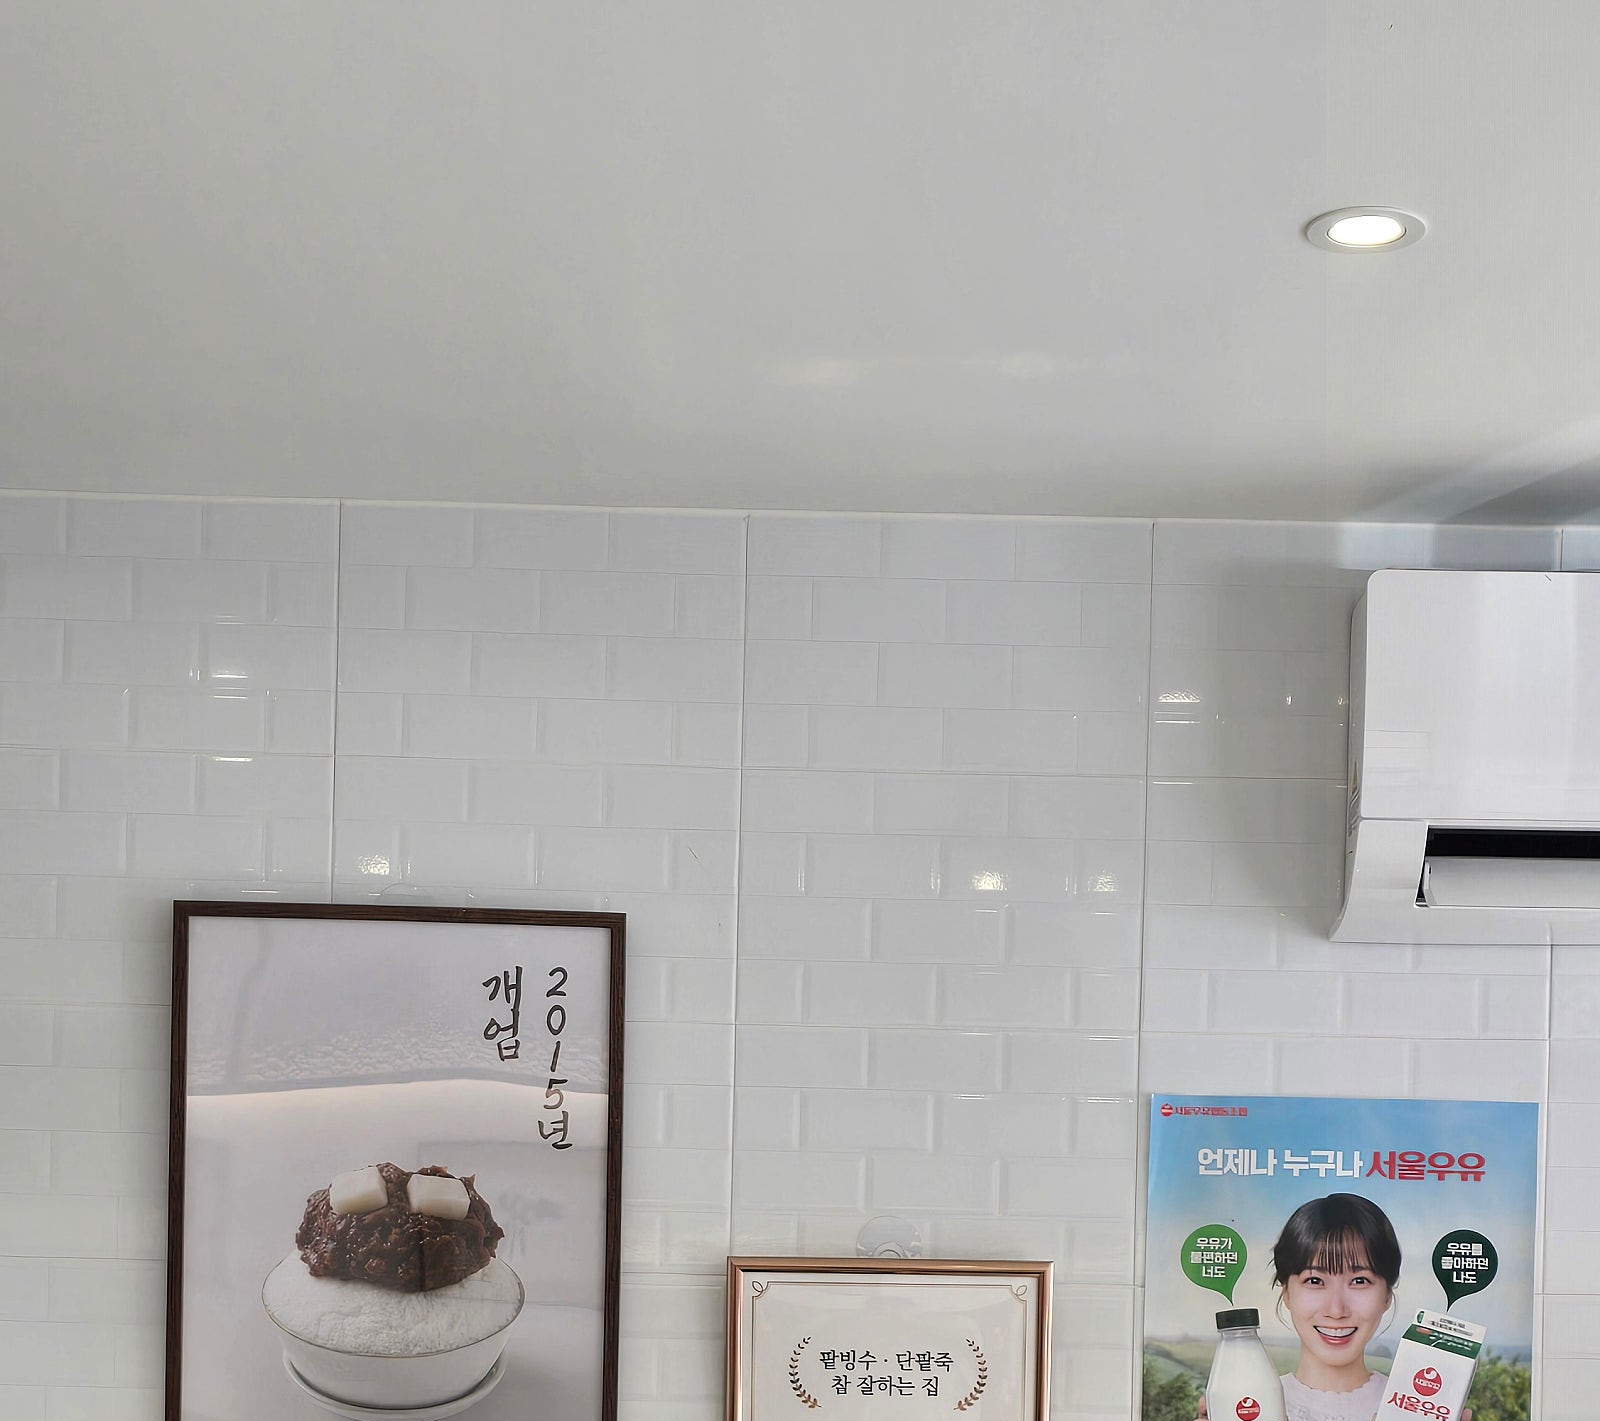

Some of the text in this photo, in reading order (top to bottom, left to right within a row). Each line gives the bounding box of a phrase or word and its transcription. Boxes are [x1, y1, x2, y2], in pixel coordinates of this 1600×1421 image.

[482, 966, 523, 1061] 개업
[537, 966, 573, 1150] 2015년
[1197, 1148, 1487, 1182] 언제나 누구나 서울우유
[1196, 1237, 1233, 1250] 우유가
[1190, 1251, 1238, 1264] 편하던
[1202, 1266, 1227, 1278] 너도
[1452, 1271, 1478, 1284] 나도
[819, 1349, 955, 1373] 팥빙수 단팥죽
[831, 1374, 939, 1397] 참 잘하는 집
[1386, 1391, 1451, 1421] 서울우유
